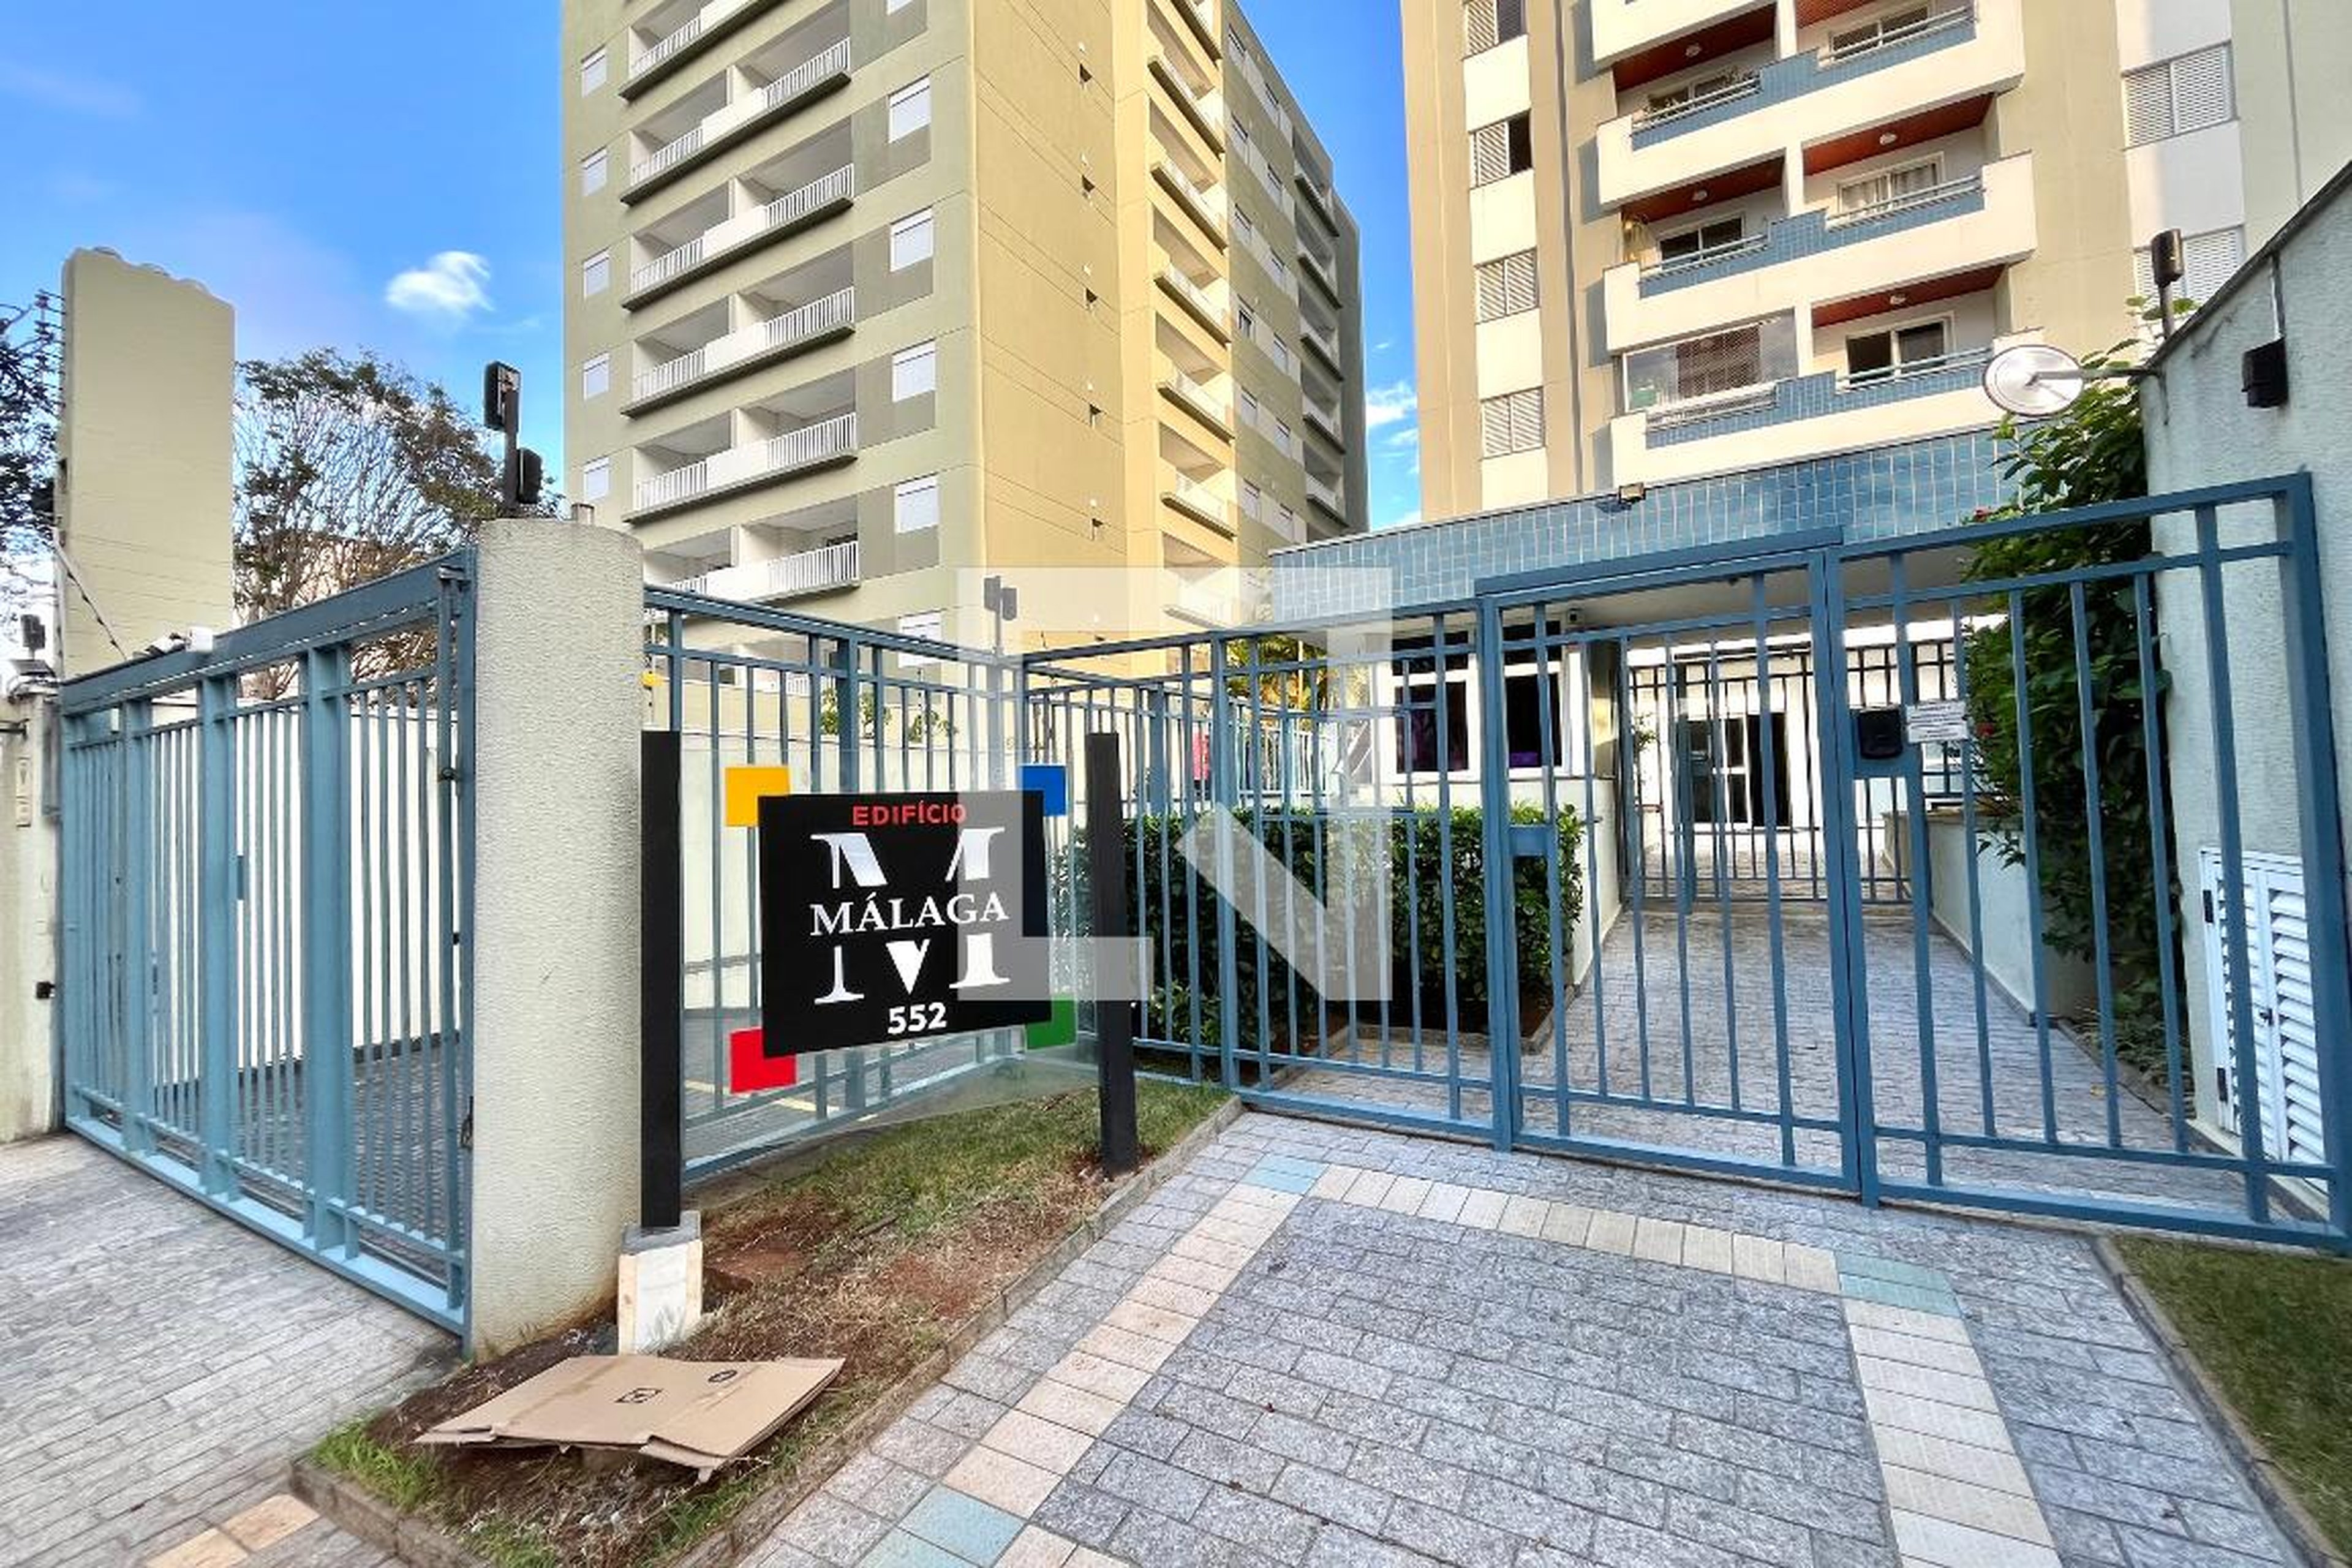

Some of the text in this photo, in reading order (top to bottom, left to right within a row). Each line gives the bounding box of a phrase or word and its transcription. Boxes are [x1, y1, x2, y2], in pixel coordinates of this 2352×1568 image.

[852, 800, 968, 826] EDIFÍCIO
[809, 891, 1010, 937] MÁLAGA
[887, 1001, 948, 1035] 552
